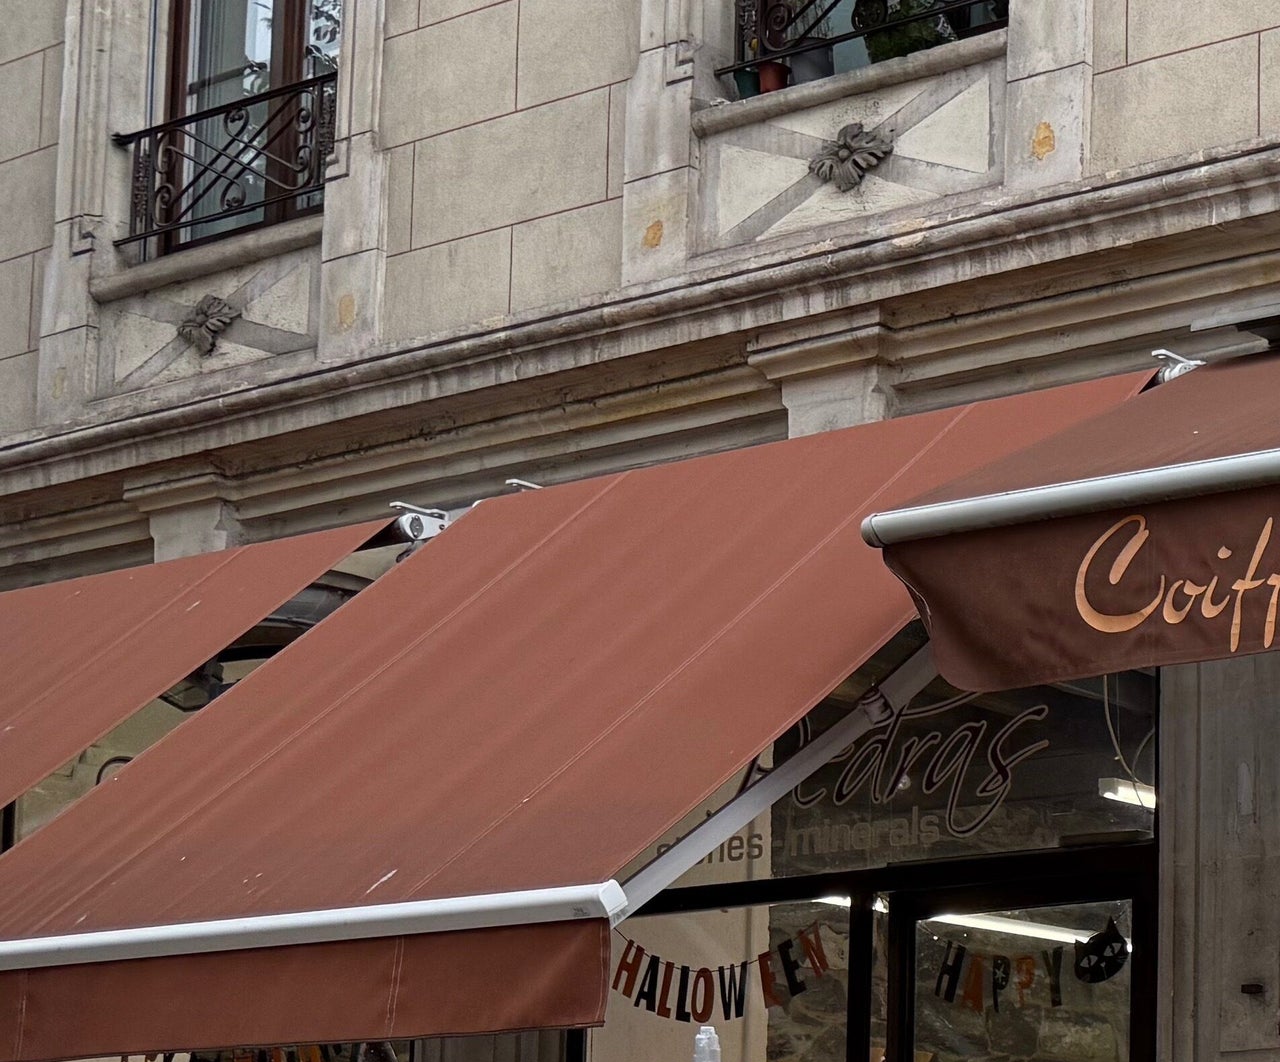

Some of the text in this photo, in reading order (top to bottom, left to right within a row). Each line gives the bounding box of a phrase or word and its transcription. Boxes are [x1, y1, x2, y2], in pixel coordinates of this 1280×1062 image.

[785, 806, 940, 857] minerals
[611, 919, 829, 1024] HALLOWEEN
[934, 940, 1064, 1014] HAPPY
